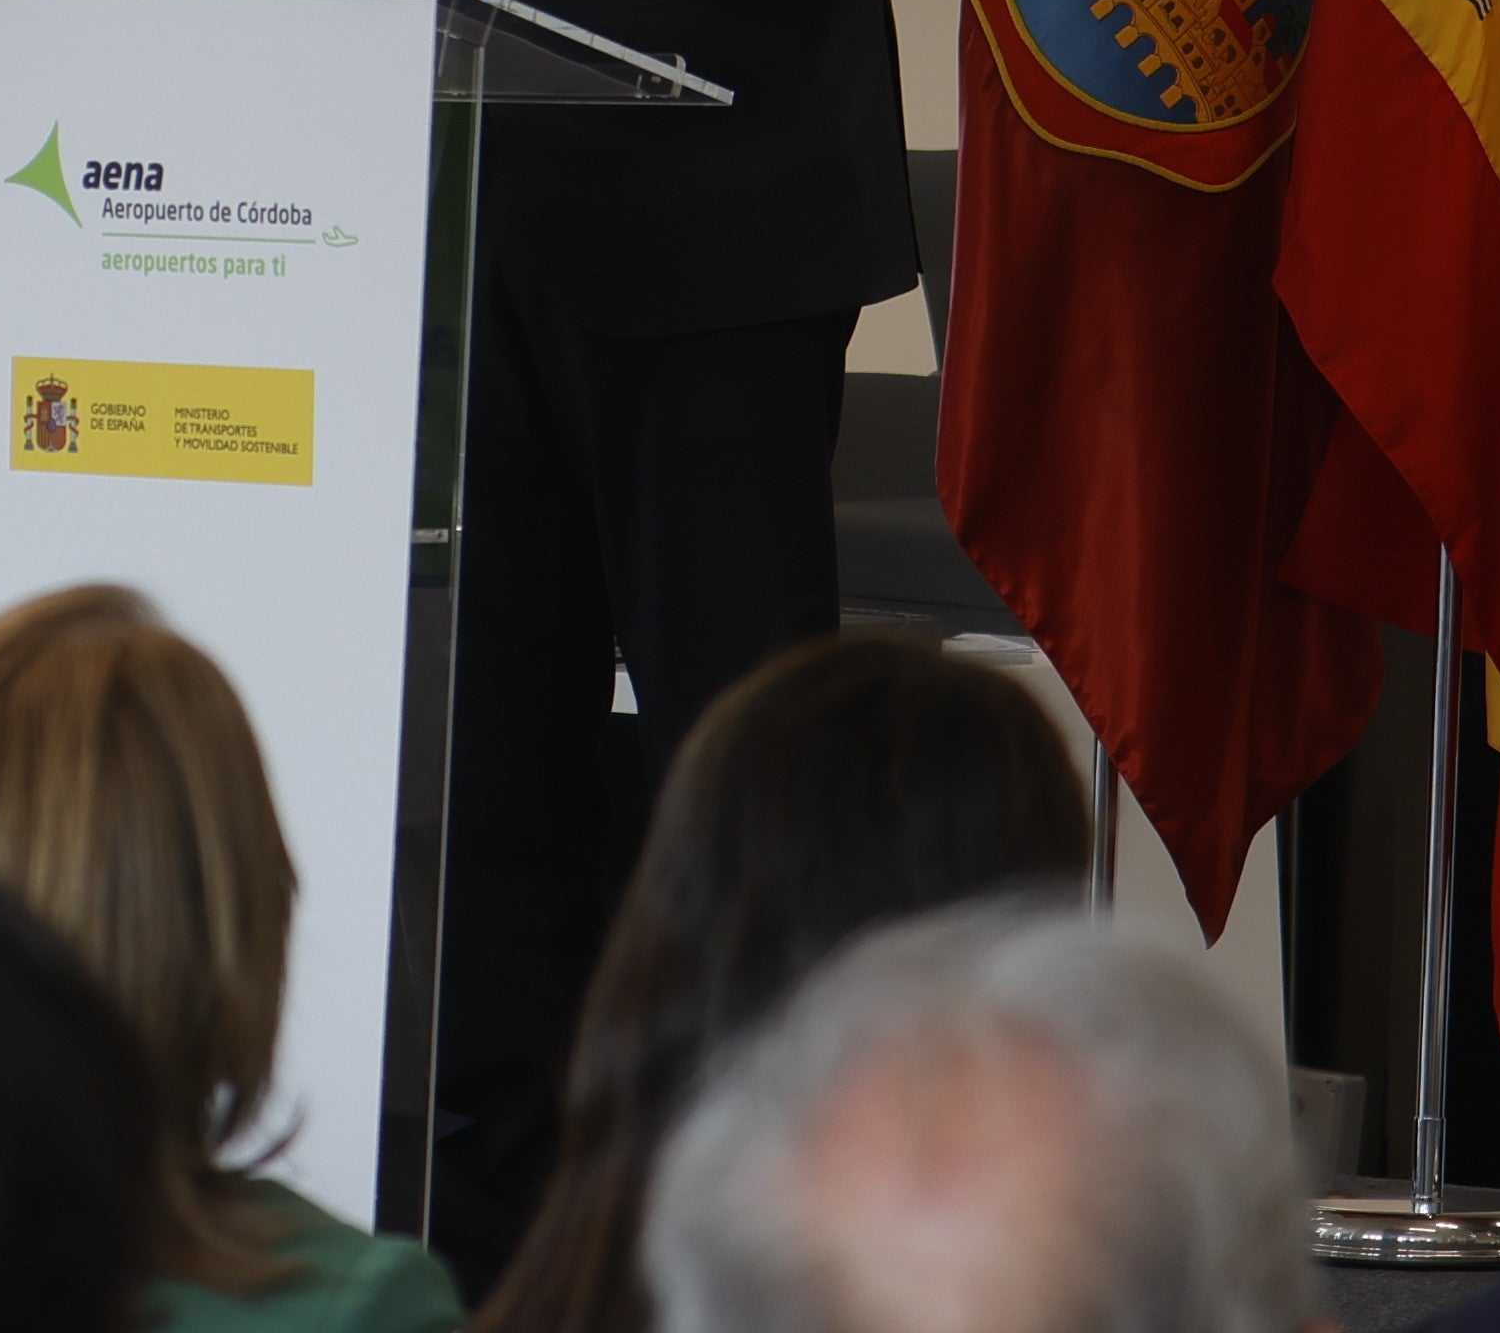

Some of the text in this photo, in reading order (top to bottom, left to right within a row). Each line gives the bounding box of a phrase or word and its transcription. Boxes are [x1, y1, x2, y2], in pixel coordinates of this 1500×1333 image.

[82, 160, 164, 191] aena
[102, 197, 312, 226] Aeropuerto de Córdoba
[101, 252, 286, 279] aeropuertos para ti
[90, 403, 146, 417] GOBIERNO
[174, 407, 230, 421] MINISTERIO
[90, 417, 145, 432] DE ESPAÑA
[174, 422, 258, 437] DE TRANSPORTES
[174, 437, 299, 455] Y MOVILIDAD SOSTENIBLE
